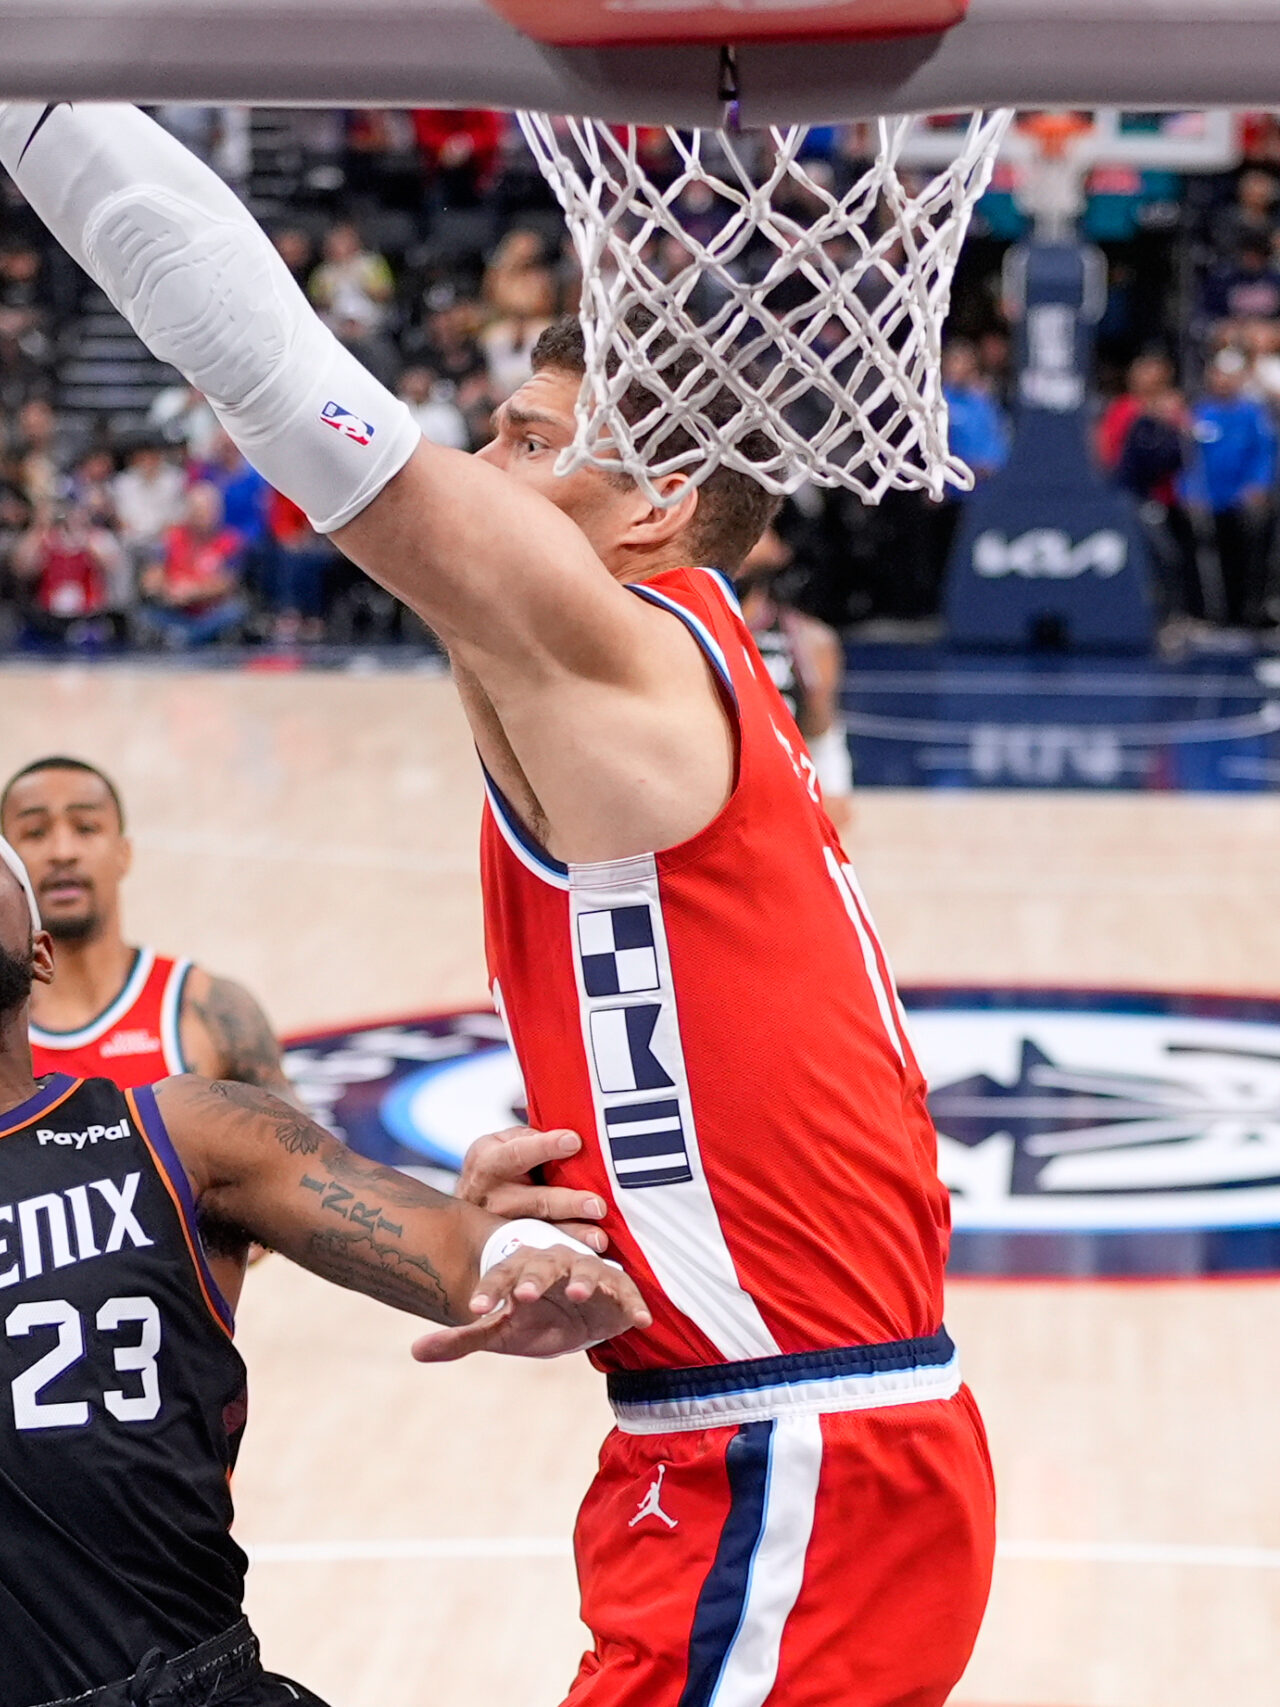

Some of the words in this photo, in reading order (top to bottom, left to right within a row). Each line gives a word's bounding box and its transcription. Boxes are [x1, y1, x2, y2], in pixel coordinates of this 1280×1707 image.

[35, 1118, 131, 1150] PayPal
[299, 1173, 403, 1239] INRI
[5, 1296, 162, 1430] 23
